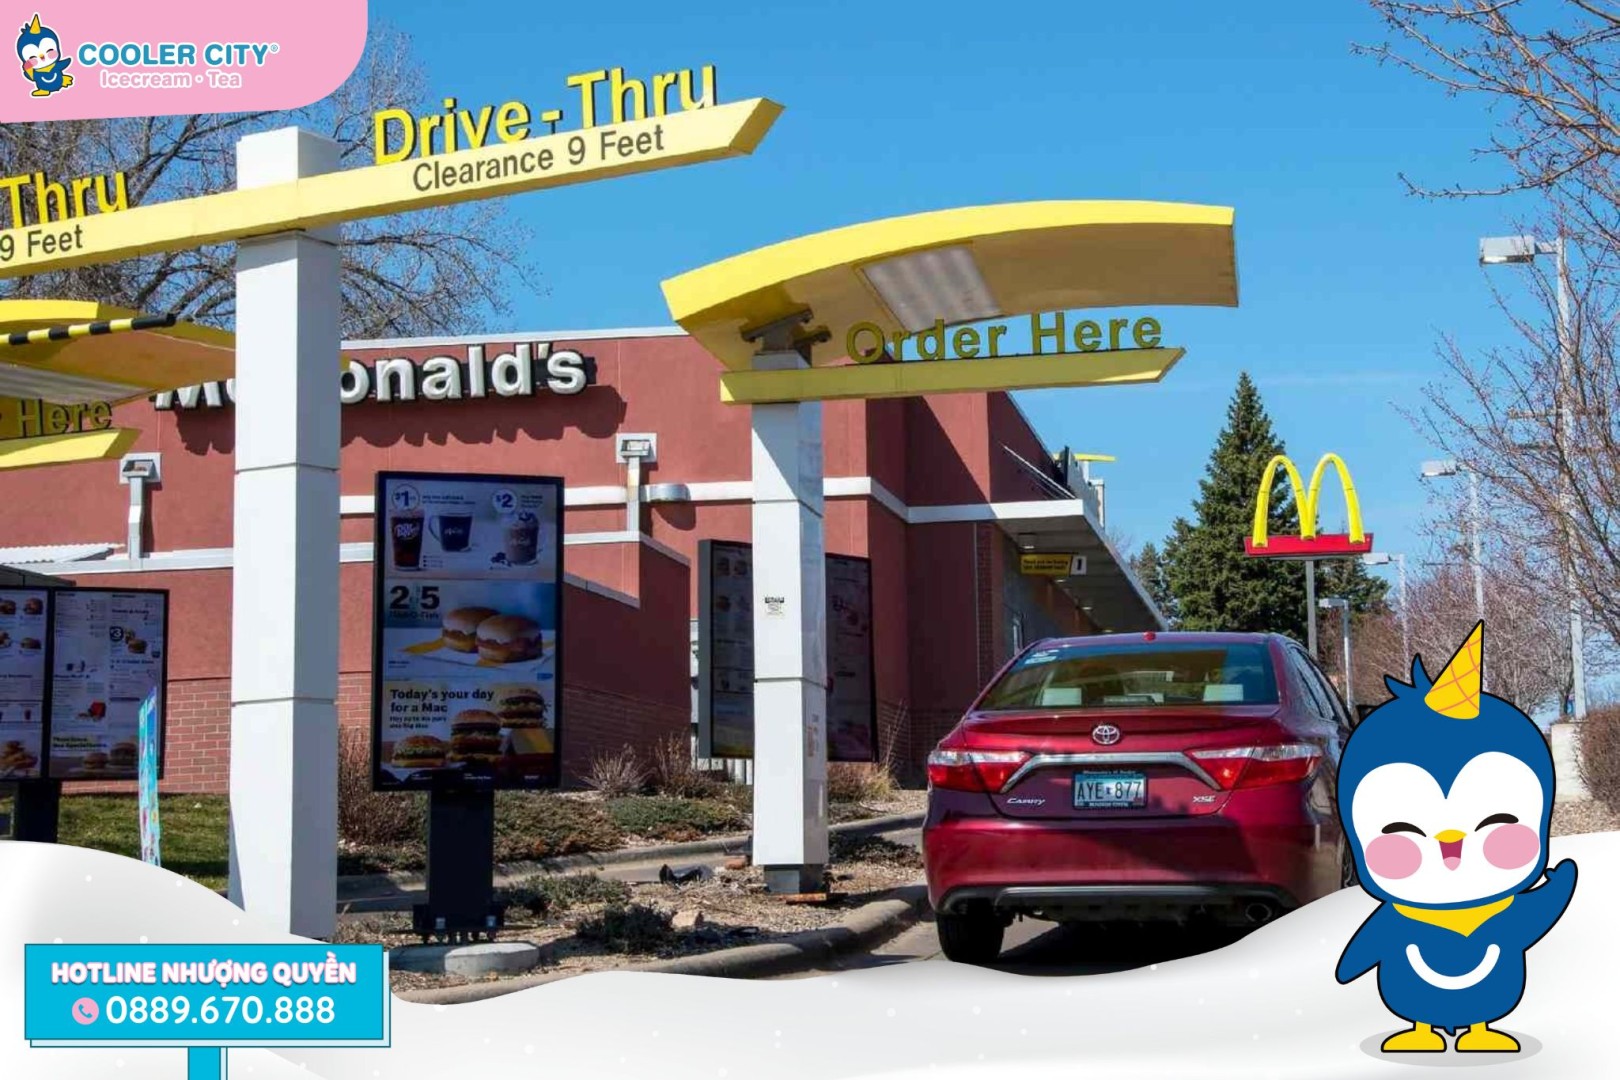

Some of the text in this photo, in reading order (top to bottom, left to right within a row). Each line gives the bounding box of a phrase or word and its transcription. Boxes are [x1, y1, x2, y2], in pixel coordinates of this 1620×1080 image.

[413, 124, 665, 192] Clearance 9 Feet
[0, 224, 84, 262] 9 Feet
[846, 311, 1162, 364] Order Here
[16, 398, 113, 437] Here
[390, 585, 410, 609] 2
[390, 688, 495, 702] Today's your day
[390, 702, 448, 713] for a Mac
[1077, 781, 1142, 801] AYE 877
